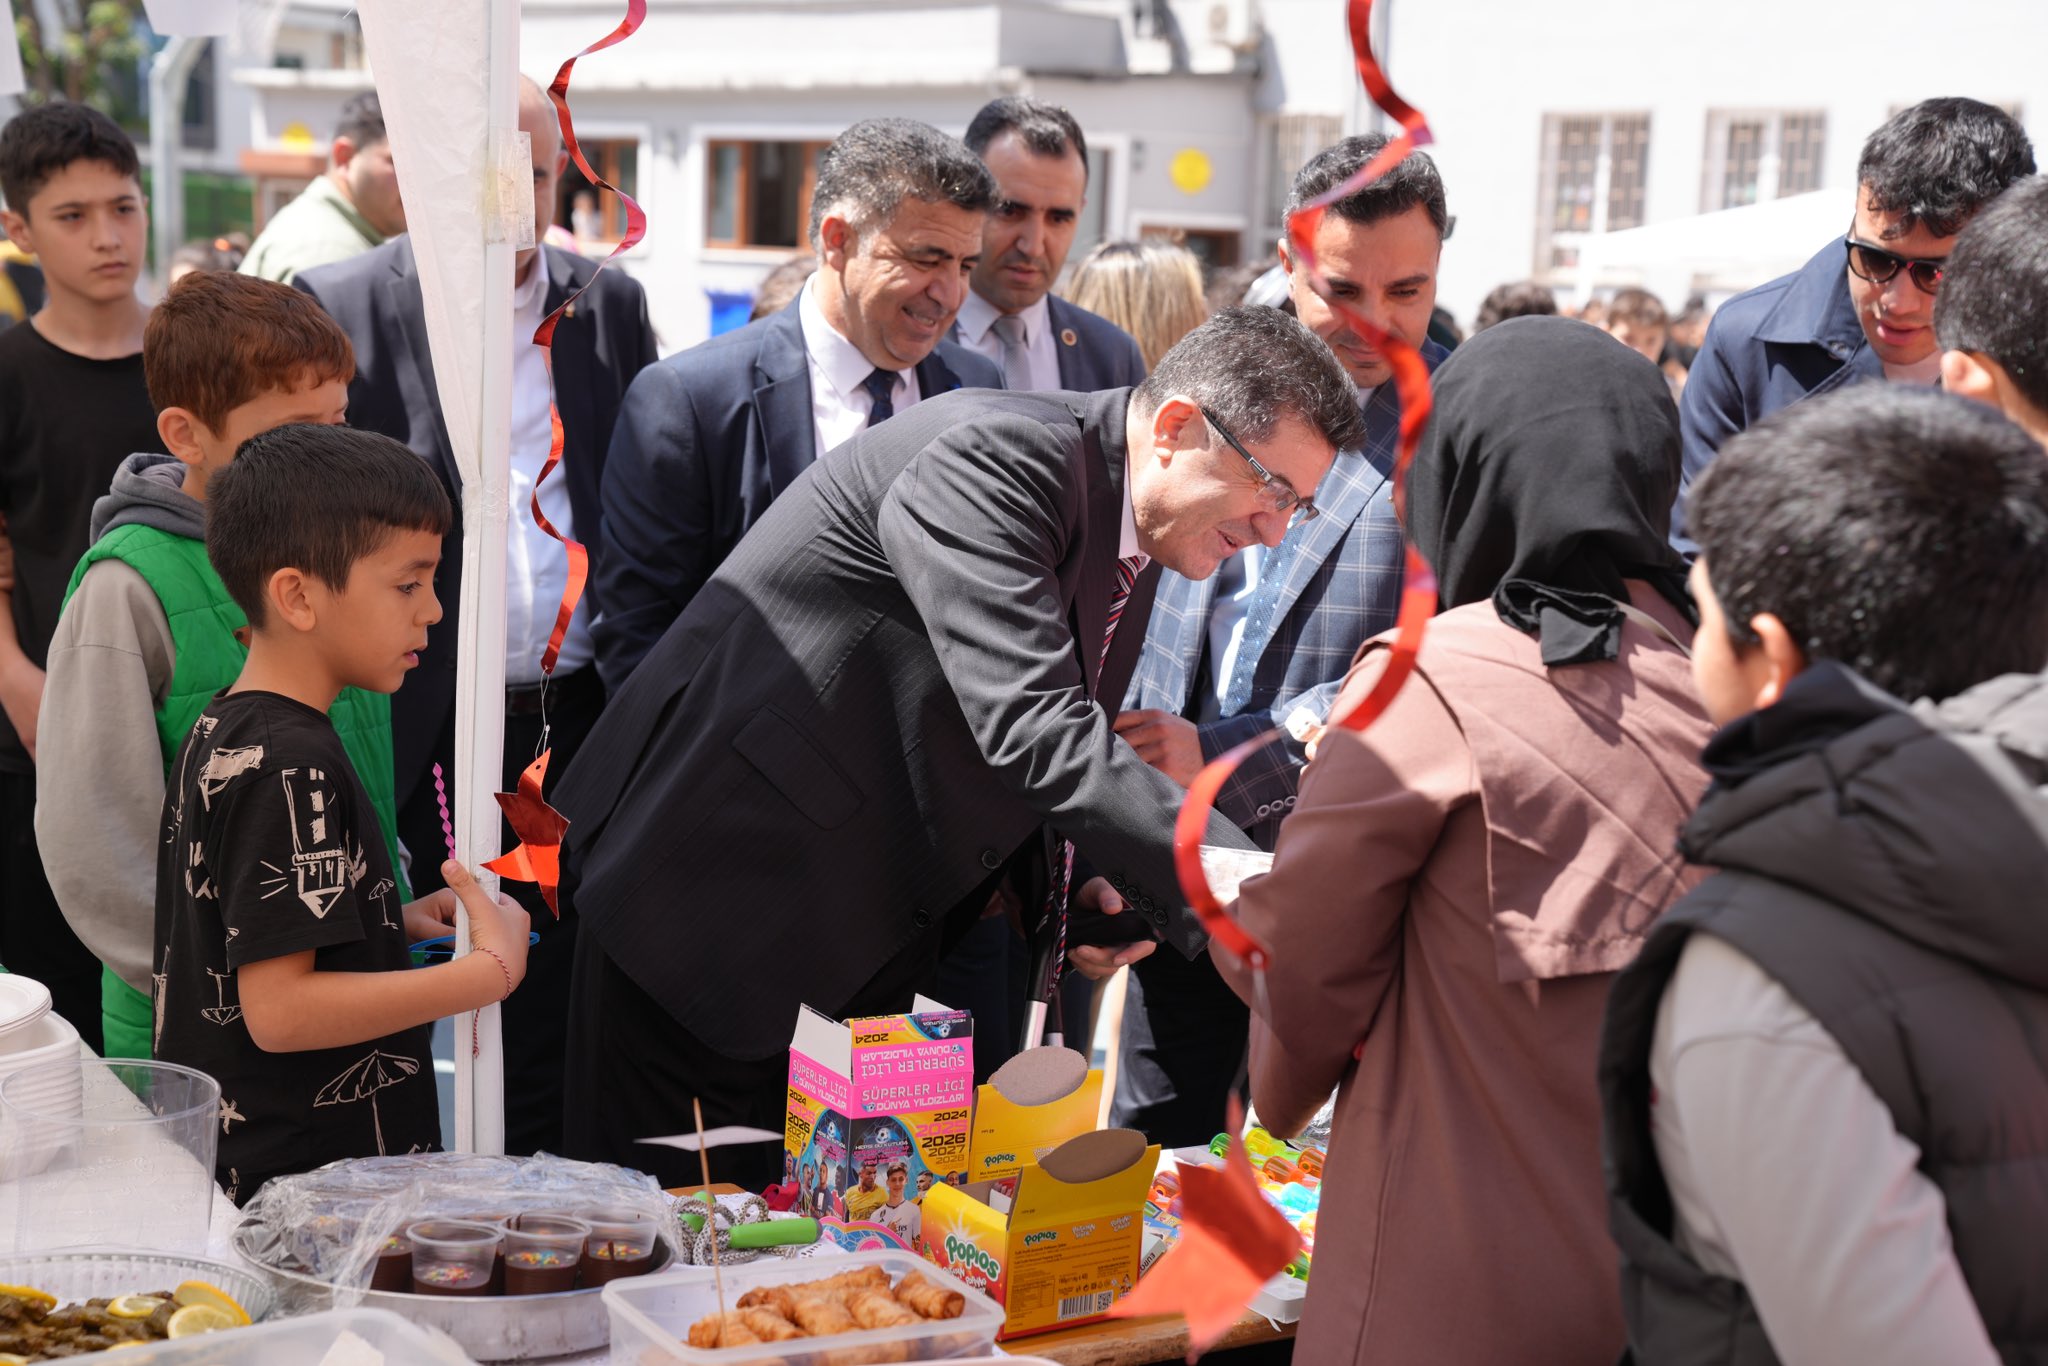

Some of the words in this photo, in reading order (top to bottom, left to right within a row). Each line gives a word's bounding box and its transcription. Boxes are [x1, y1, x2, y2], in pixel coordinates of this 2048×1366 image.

[854, 1017, 906, 1035] 2025
[855, 1033, 889, 1044] 2024
[861, 1048, 914, 1062] YILDIZLARI
[917, 1045, 951, 1057] DÜNYA
[861, 1063, 892, 1079] LİGİ
[898, 1055, 965, 1073] SÜPERLER
[793, 1059, 828, 1088] SÜPERLER
[789, 1089, 807, 1106] 2024
[862, 1083, 931, 1102] SÜPERLER
[936, 1077, 965, 1093] LİGİ
[876, 1099, 910, 1112] DÜNYA
[913, 1093, 965, 1107] YILDIZLARI
[788, 1099, 816, 1124] 2025
[934, 1110, 967, 1122] 2024
[788, 1111, 811, 1134] 2026
[915, 1120, 968, 1138] 2025
[787, 1123, 806, 1141] 2027
[922, 1133, 966, 1149] 2026
[928, 1144, 966, 1158] 2027
[936, 1154, 965, 1165] 2028
